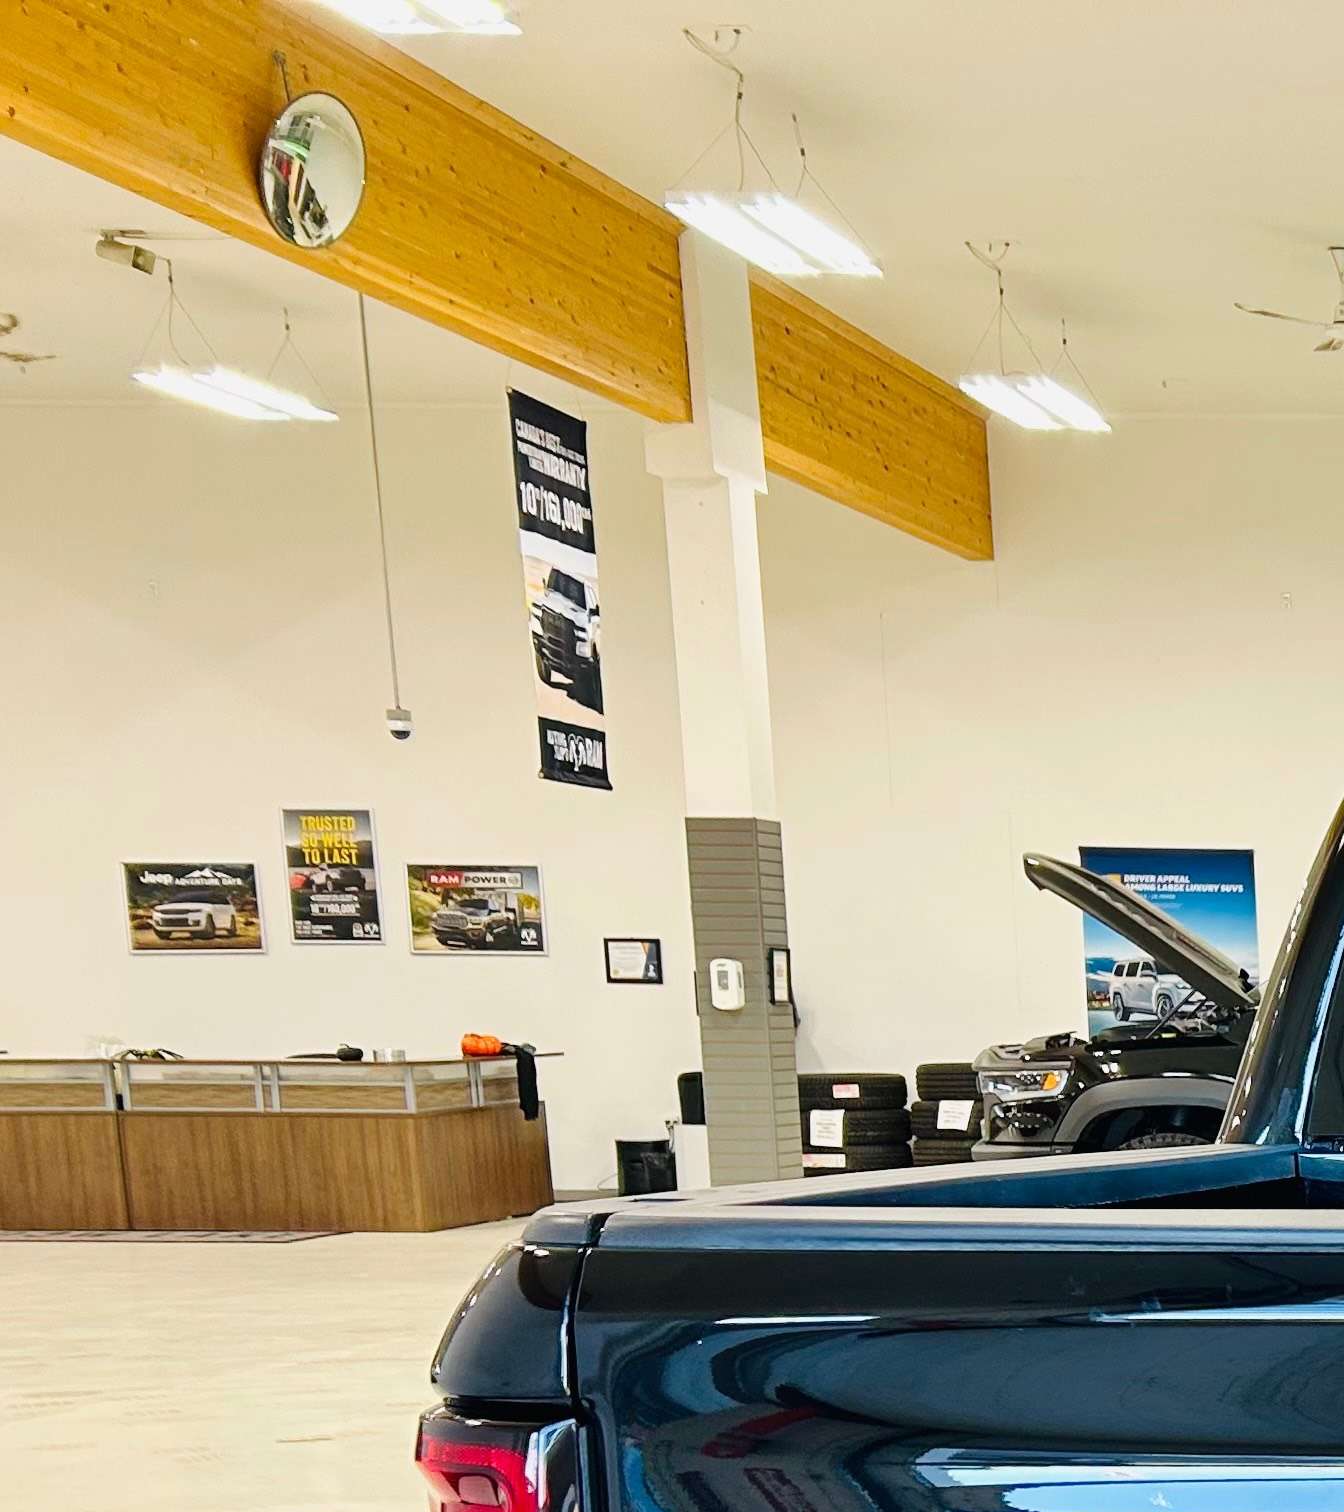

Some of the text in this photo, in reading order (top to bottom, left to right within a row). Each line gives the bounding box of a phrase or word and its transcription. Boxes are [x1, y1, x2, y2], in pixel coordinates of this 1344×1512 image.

[299, 815, 357, 832] TRUSTED
[302, 831, 358, 848] SO WELL
[302, 848, 359, 865] TO LAST
[140, 870, 175, 887] Jeep
[430, 874, 507, 884] RAM POWER
[1124, 874, 1190, 884] DRIVER APPEAL
[1185, 884, 1220, 893] LUXURY
